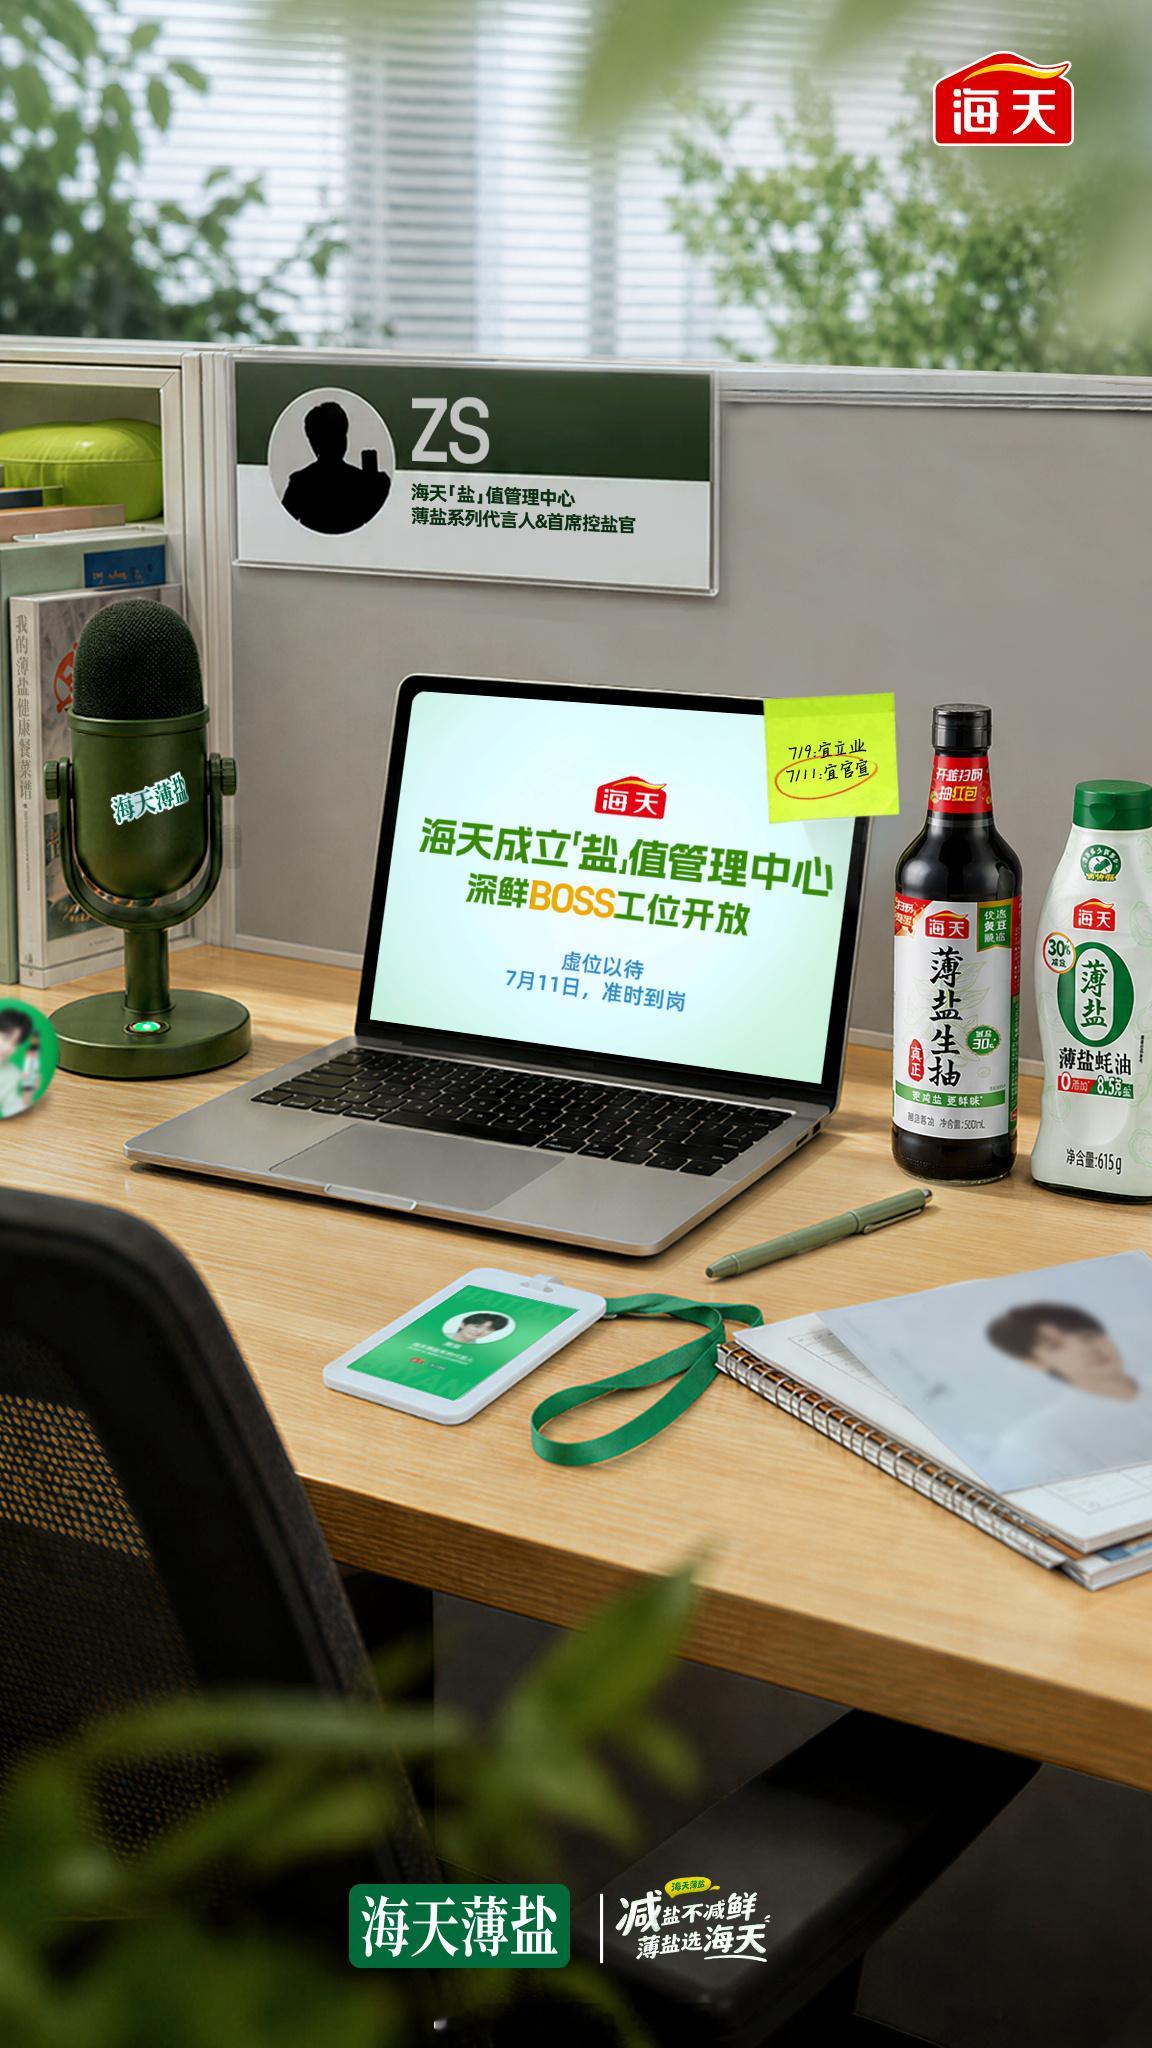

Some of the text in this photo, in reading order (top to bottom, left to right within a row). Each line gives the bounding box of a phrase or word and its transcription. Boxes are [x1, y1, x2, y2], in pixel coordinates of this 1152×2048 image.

[411, 396, 490, 465] ZS
[411, 507, 637, 534] 薄盐系列代言人&首席控盐官
[111, 773, 188, 824] 海天薄盐
[602, 788, 660, 815] 海天
[929, 918, 964, 937] 海天
[1078, 909, 1111, 929] 海天
[561, 951, 645, 981] 虚位以待
[1080, 959, 1109, 1028] 薄盐
[928, 945, 964, 1087] 薄盐生抽
[1059, 1047, 1132, 1076] 薄盐蚝油
